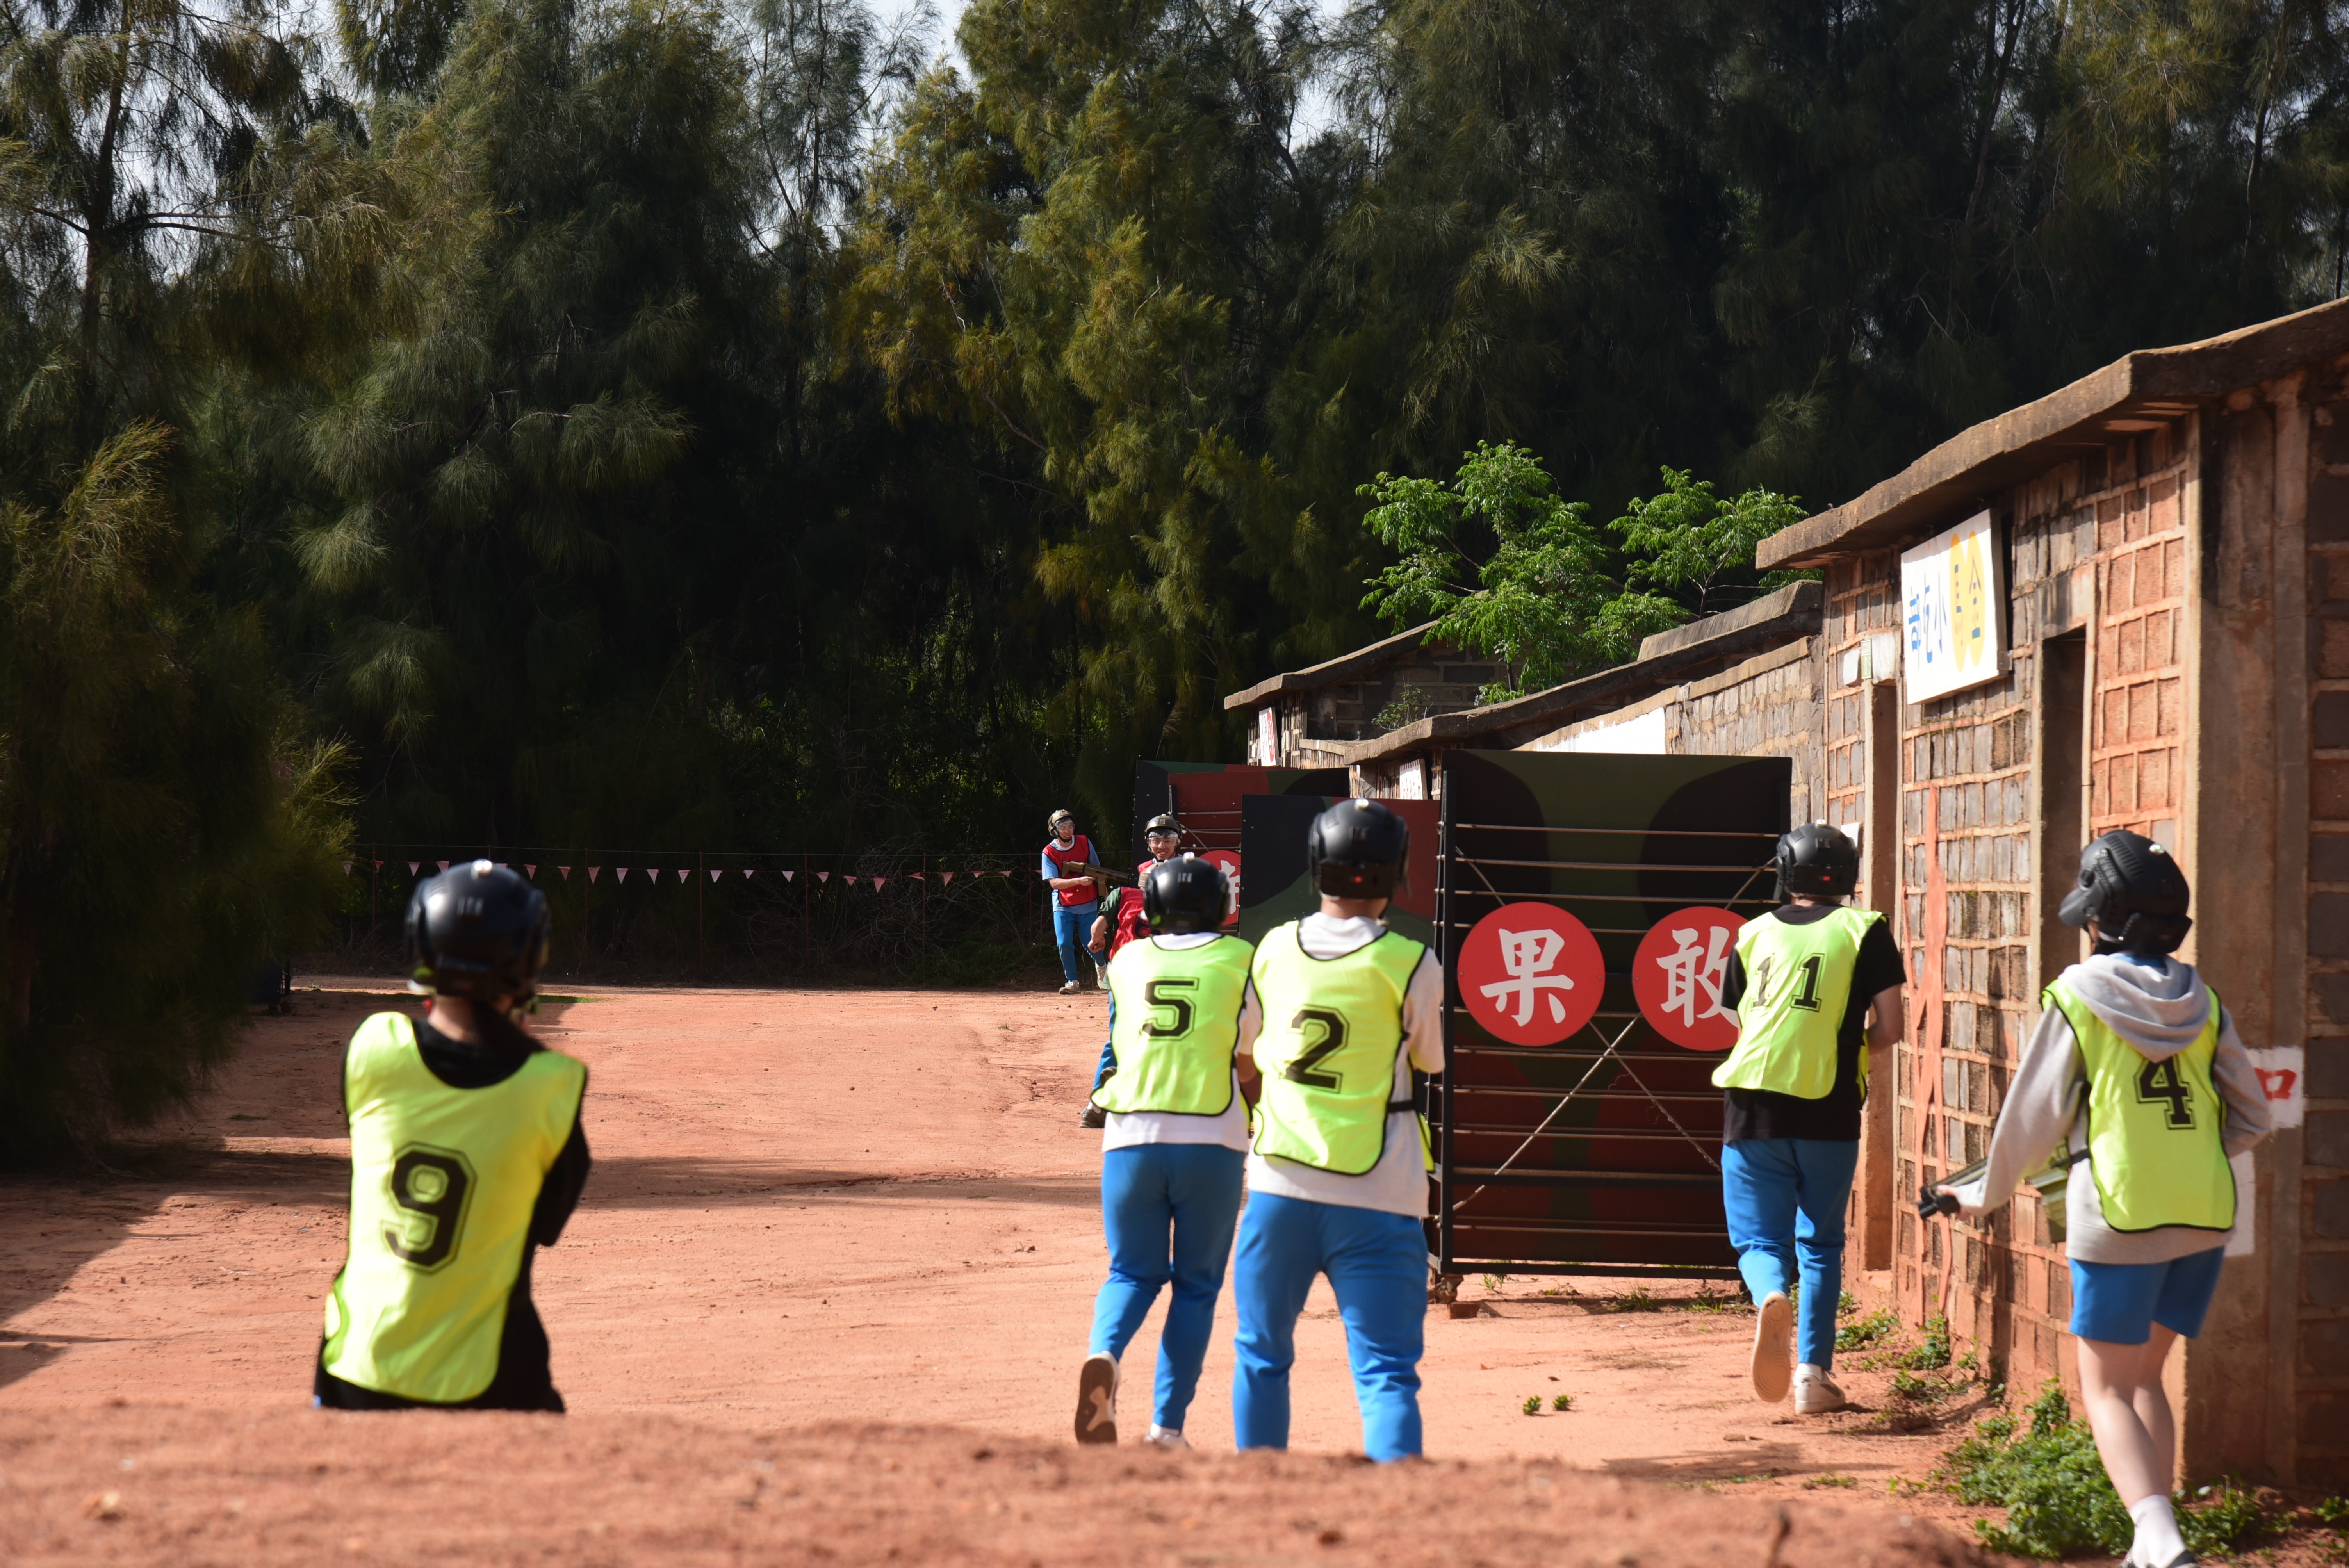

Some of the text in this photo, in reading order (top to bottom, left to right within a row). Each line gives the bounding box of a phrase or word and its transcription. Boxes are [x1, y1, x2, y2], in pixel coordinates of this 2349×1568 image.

[1139, 976, 1199, 1040] 5
[1751, 953, 1826, 1012] 11
[1285, 1005, 1350, 1092] 2
[2133, 1055, 2196, 1130] 4
[381, 1141, 478, 1275] 9
